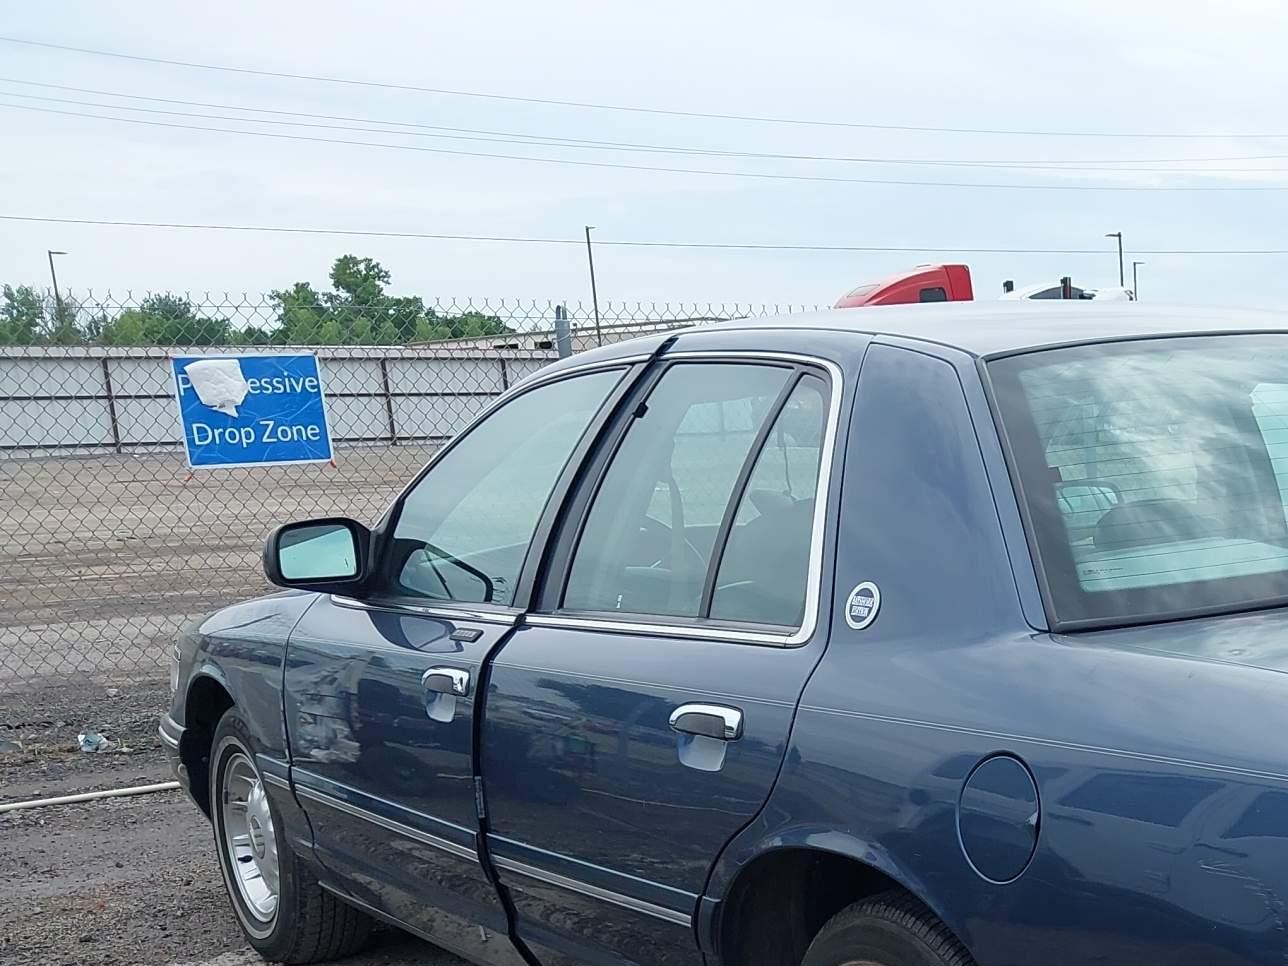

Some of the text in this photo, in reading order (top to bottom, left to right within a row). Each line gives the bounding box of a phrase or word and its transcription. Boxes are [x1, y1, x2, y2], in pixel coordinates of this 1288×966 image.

[177, 372, 318, 396] Pessive
[192, 420, 321, 448] Drop Zone
